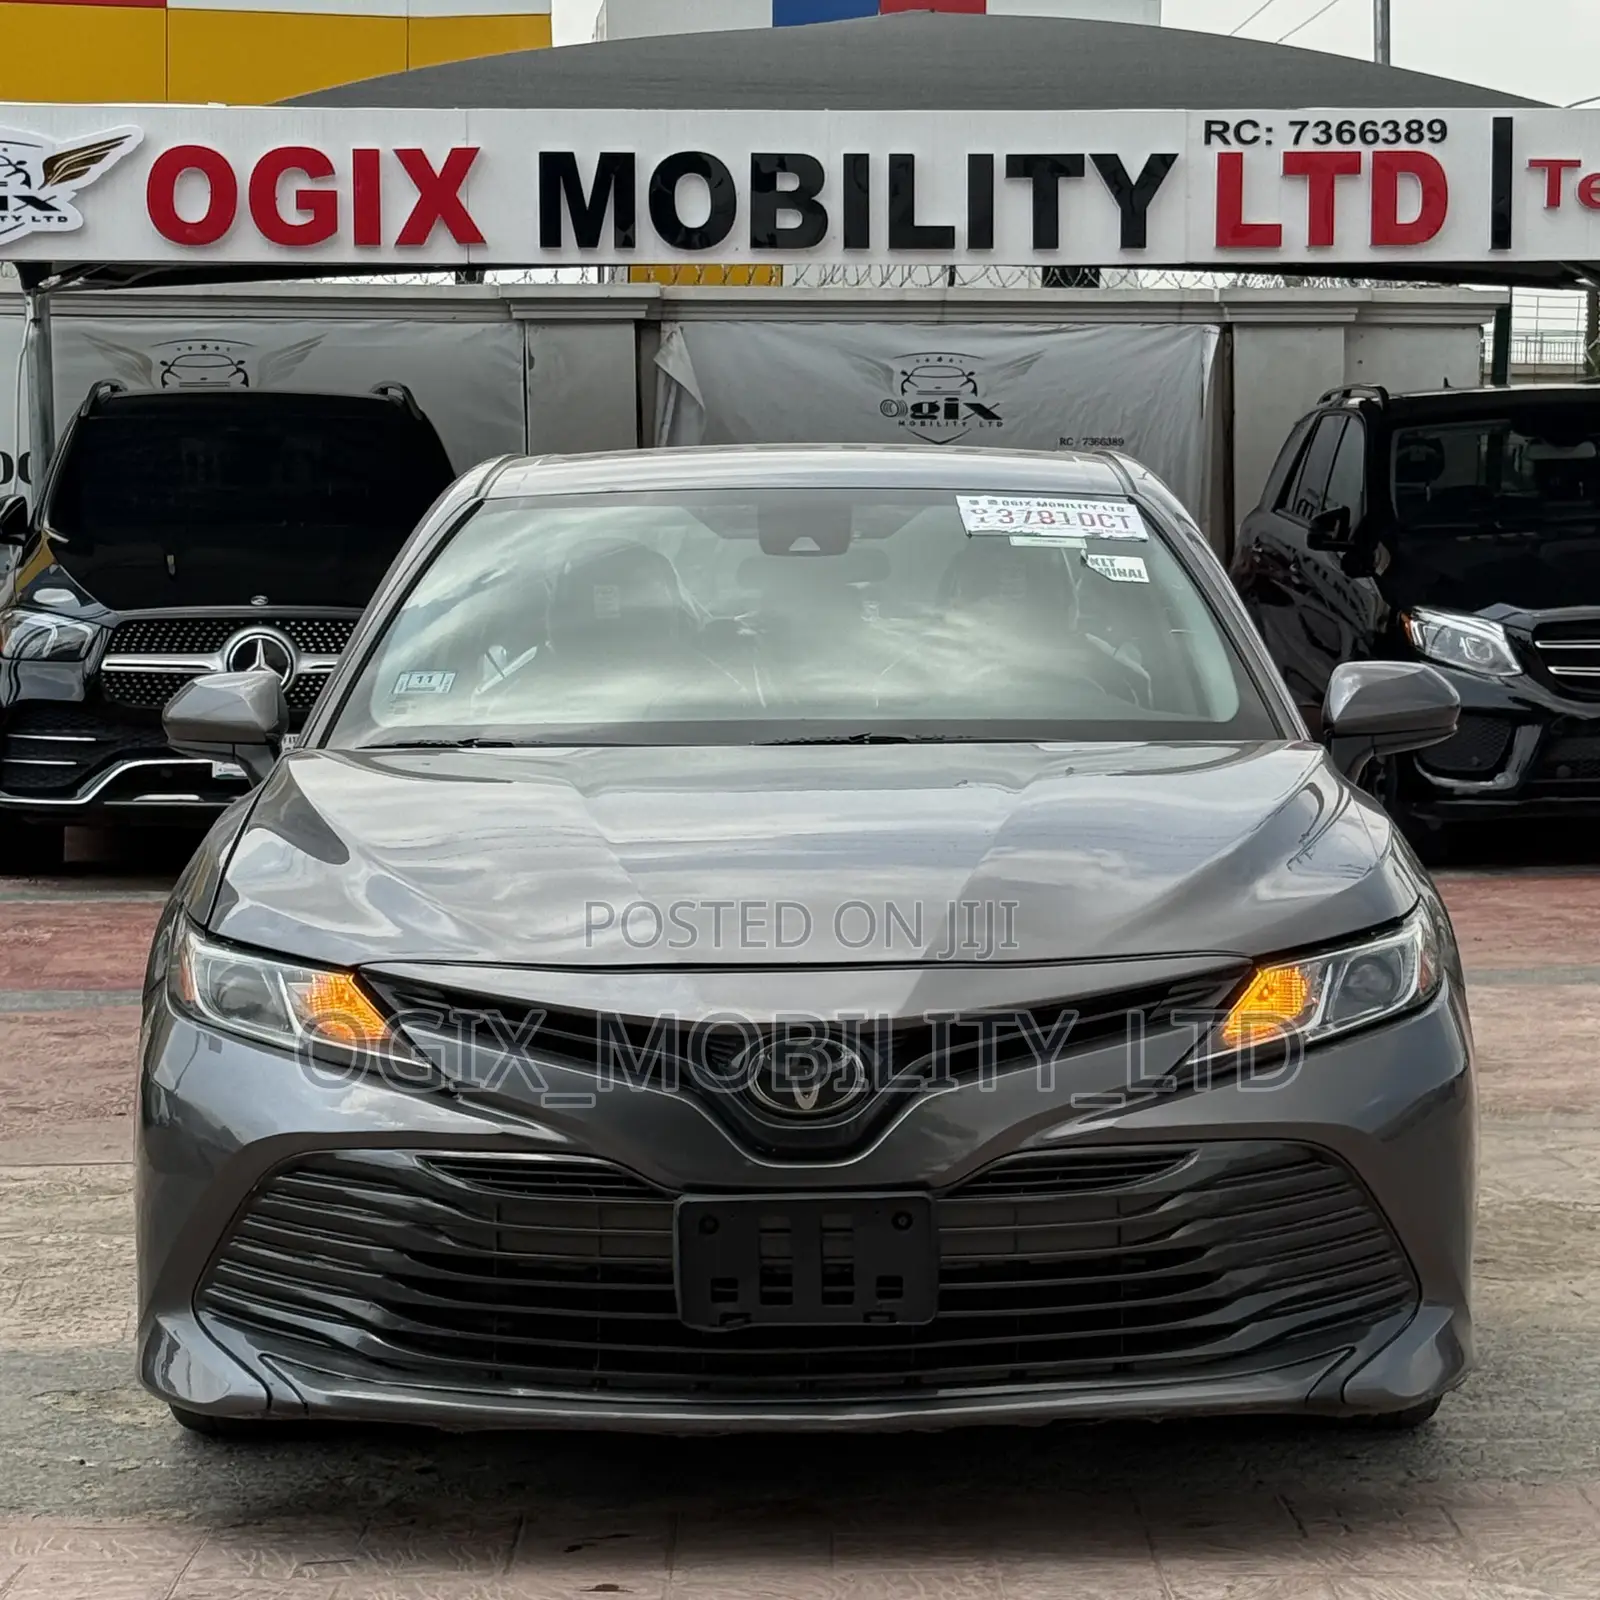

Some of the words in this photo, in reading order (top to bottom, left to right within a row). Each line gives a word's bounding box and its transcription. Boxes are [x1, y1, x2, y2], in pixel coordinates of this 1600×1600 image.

[1204, 119, 1274, 146] RC:
[1288, 118, 1449, 146] 7366389
[146, 144, 488, 248] OGIX
[538, 150, 1180, 250] MOBILITY
[1215, 149, 1449, 248] LTD
[31, 214, 68, 223] LTD
[898, 420, 967, 428] MOBILITY
[979, 420, 1004, 428] LTD
[1059, 437, 1074, 446] RC
[416, 675, 433, 684] 11
